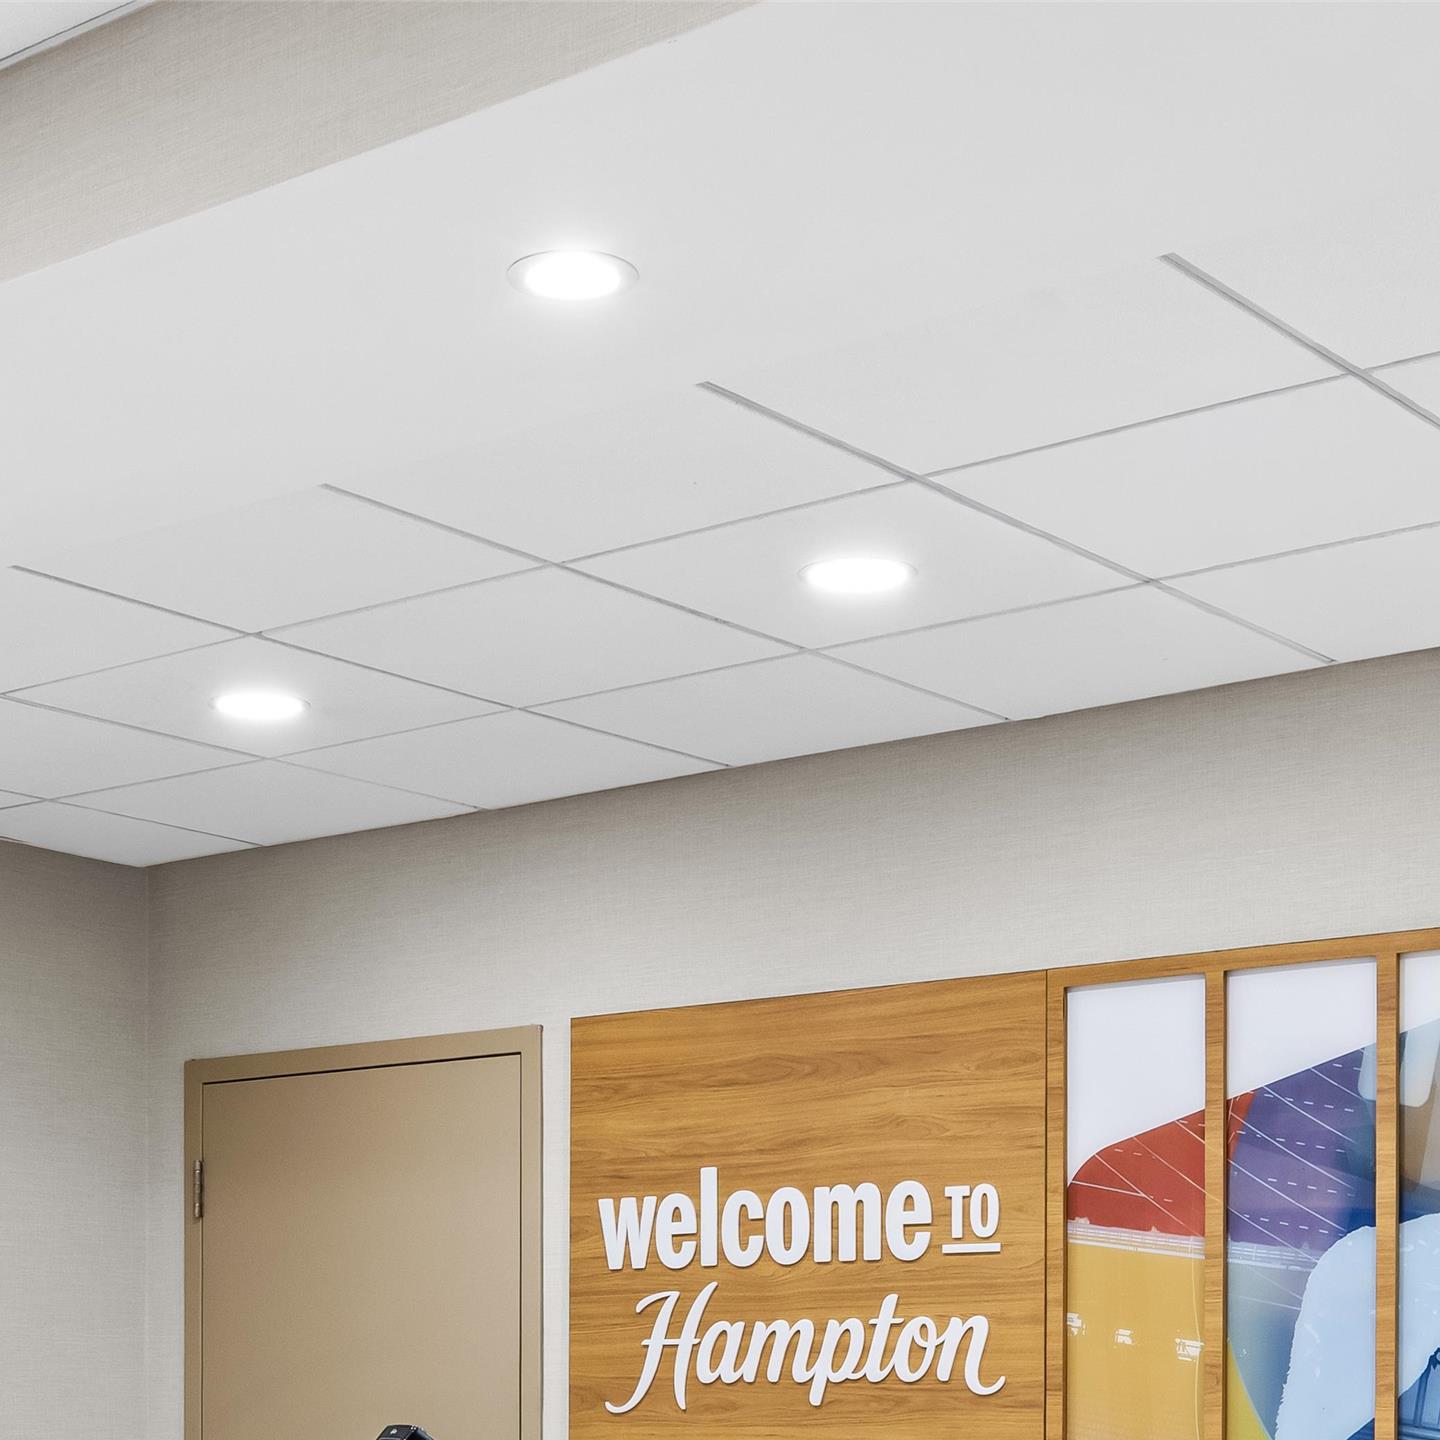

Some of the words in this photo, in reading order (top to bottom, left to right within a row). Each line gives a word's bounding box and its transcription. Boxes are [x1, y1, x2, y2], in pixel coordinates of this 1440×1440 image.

[597, 1166, 933, 1271] welcome
[943, 1182, 1000, 1239] TO
[604, 1281, 1006, 1414] Hampton
